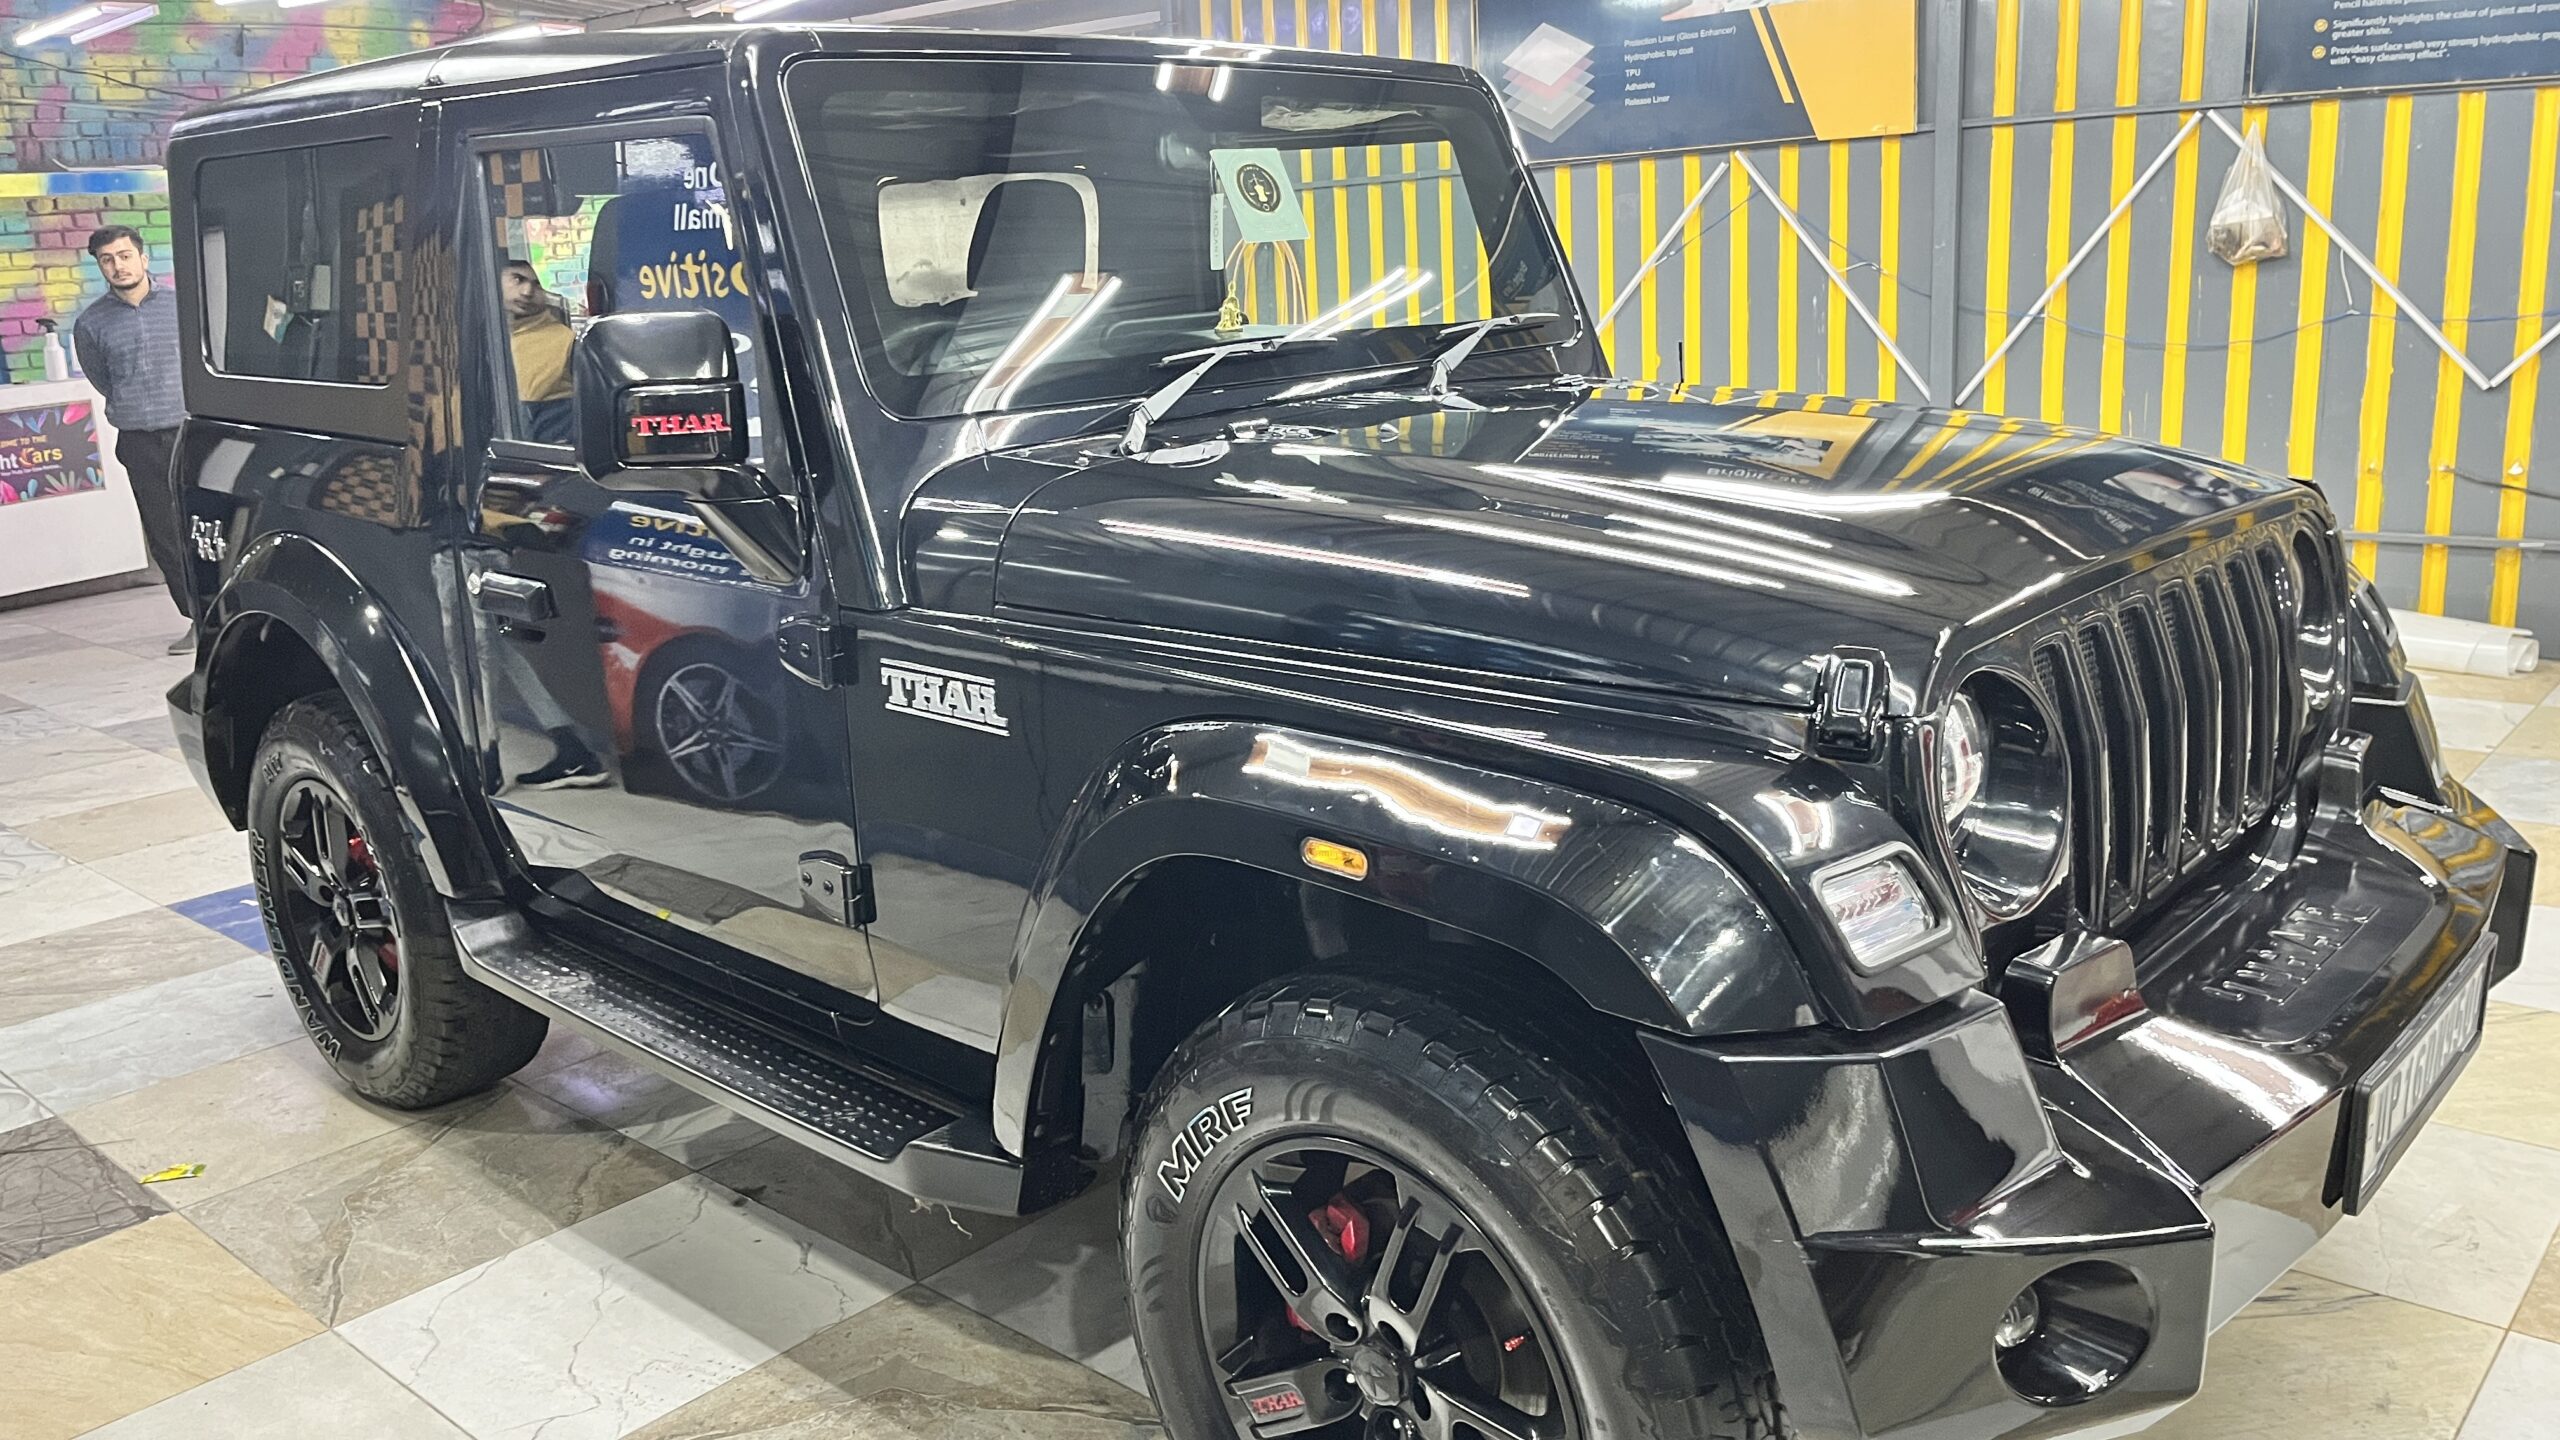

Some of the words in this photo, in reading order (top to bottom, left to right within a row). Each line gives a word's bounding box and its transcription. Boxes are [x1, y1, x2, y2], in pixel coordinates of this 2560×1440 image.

[2333, 17, 2388, 30] Significantly
[2388, 13, 2434, 25] highlights
[2435, 11, 2452, 20] the
[2452, 8, 2477, 19] color
[2477, 6, 2490, 18] of
[2489, 6, 2516, 18] paint
[2516, 3, 2537, 14] and
[1624, 37, 1658, 48] Protection
[1658, 34, 1676, 44] Liner
[1676, 31, 1699, 42] (Gloss
[1700, 25, 1737, 38] Enhancer)
[2330, 44, 2369, 55] Provides
[2370, 42, 2403, 53] surface
[2404, 40, 2425, 50] with
[2426, 40, 2447, 50] very
[2447, 37, 2478, 48] strong
[2480, 31, 2541, 47] hydrophobic
[2331, 29, 2365, 41] greater
[2366, 26, 2392, 36] shine.
[1624, 50, 1666, 63] Hydrophobic
[1666, 49, 1678, 58] top
[1679, 46, 1694, 55] coat
[2330, 55, 2351, 65] with
[2376, 52, 2416, 62] cleaning
[1625, 68, 1641, 77] TPU
[1624, 82, 1656, 91] Adhesive
[1624, 97, 1652, 107] Release
[1652, 95, 1670, 104] Liner
[631, 413, 731, 437] THAR
[20, 437, 30, 445] TO
[32, 434, 48, 443] THE
[880, 665, 1009, 728] THAR
[251, 829, 342, 1062] WANDERER
[1157, 1086, 1253, 1204] MRF
[1251, 1390, 1305, 1415] THAR
